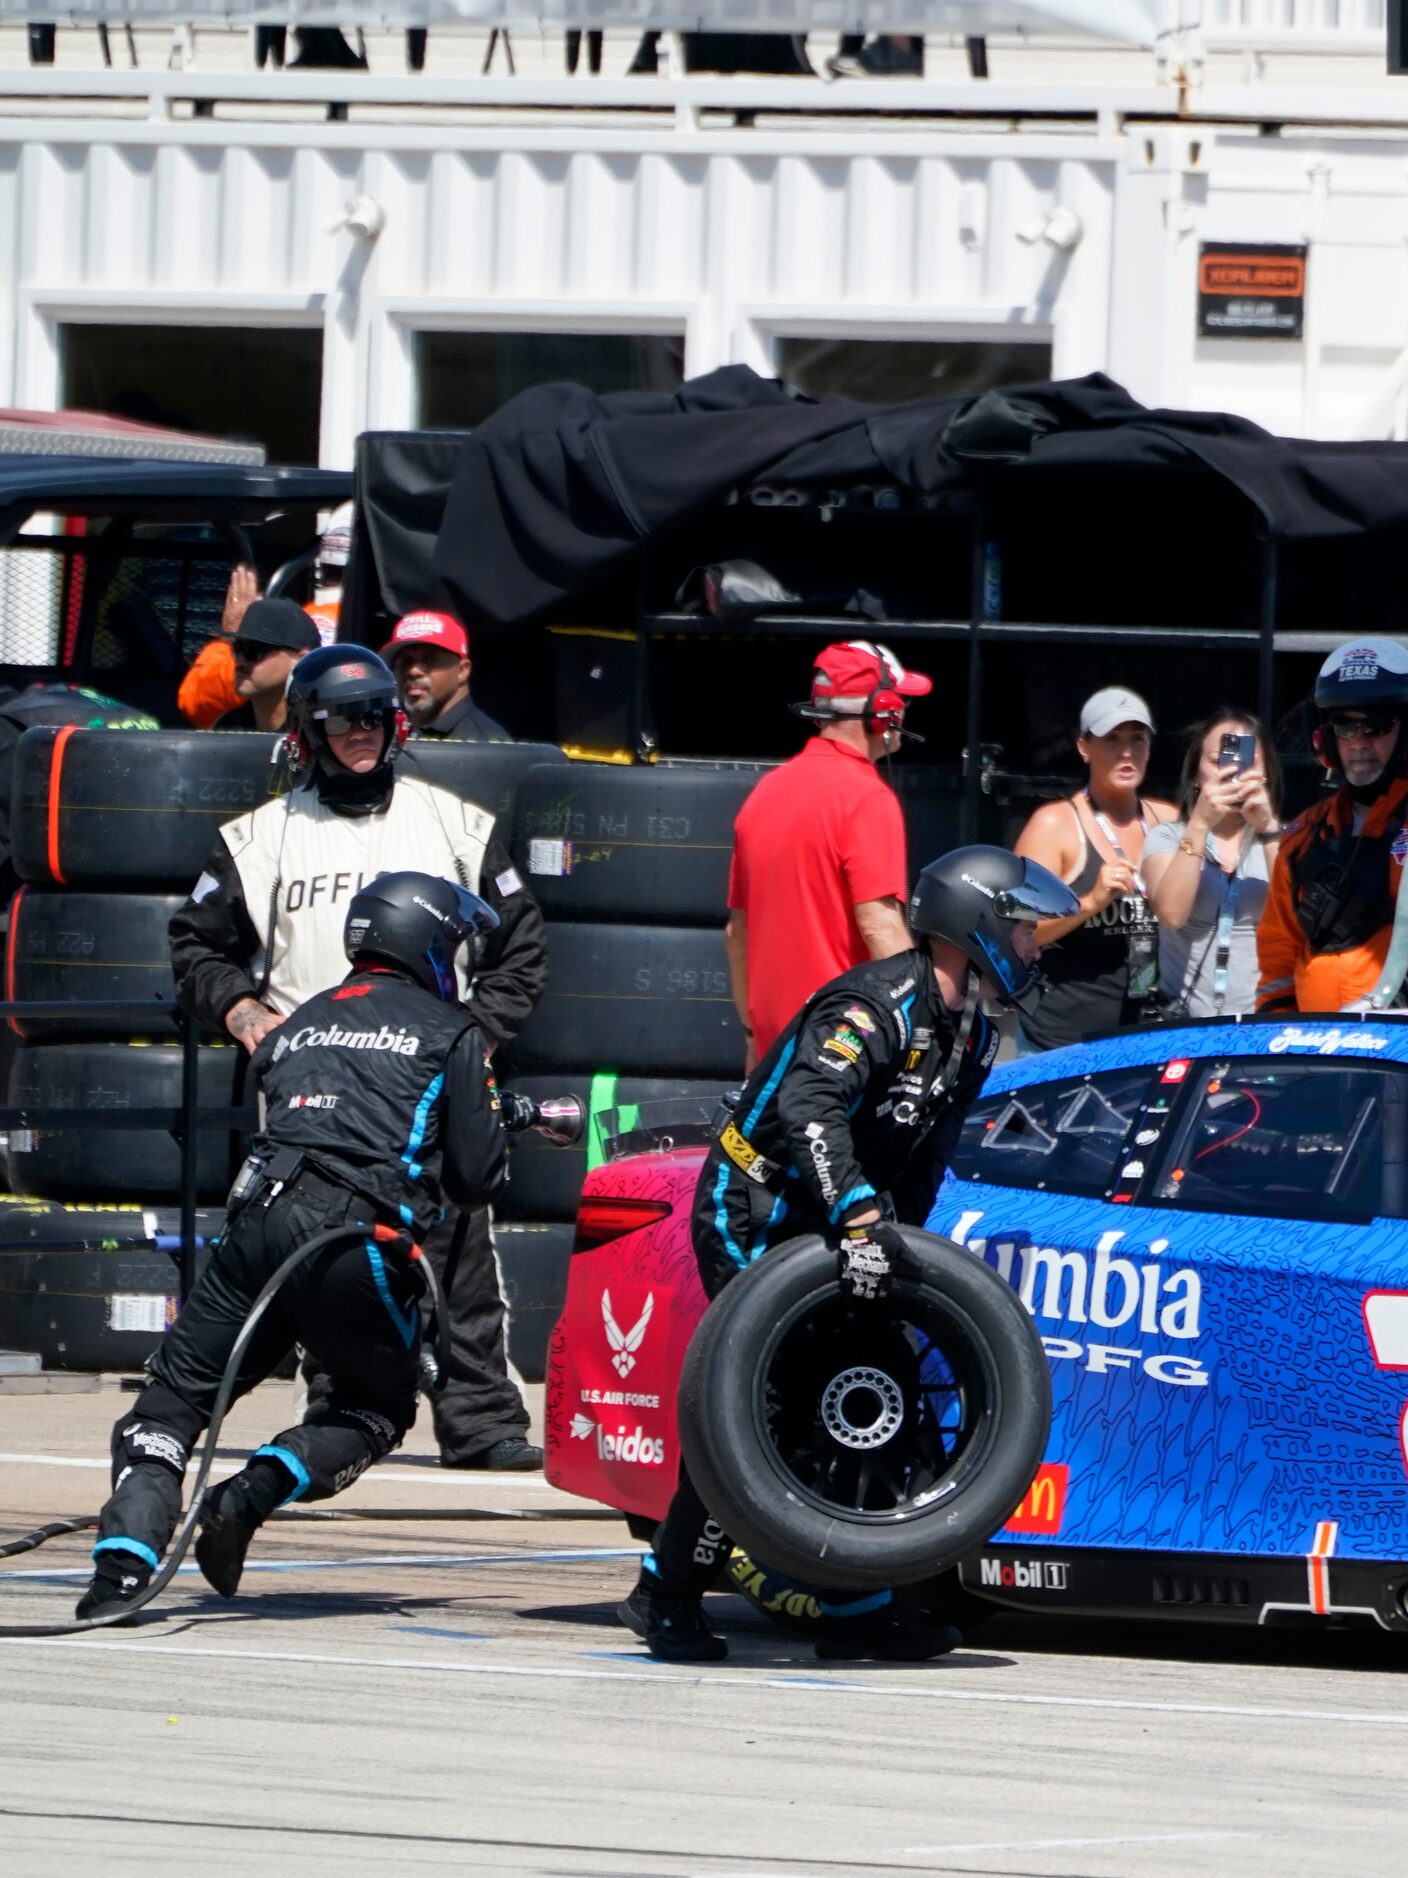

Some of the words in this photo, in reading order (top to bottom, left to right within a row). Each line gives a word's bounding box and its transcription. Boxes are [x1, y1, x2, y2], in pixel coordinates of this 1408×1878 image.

[1338, 666, 1379, 677] TEXAS
[289, 1024, 420, 1056] Columbia
[289, 1096, 322, 1108] Mobil
[581, 1389, 601, 1403] U.S.
[602, 1391, 624, 1405] AIR
[625, 1393, 660, 1408] FORCE
[596, 1423, 664, 1465] leidos
[980, 1558, 1042, 1588] Mobil
